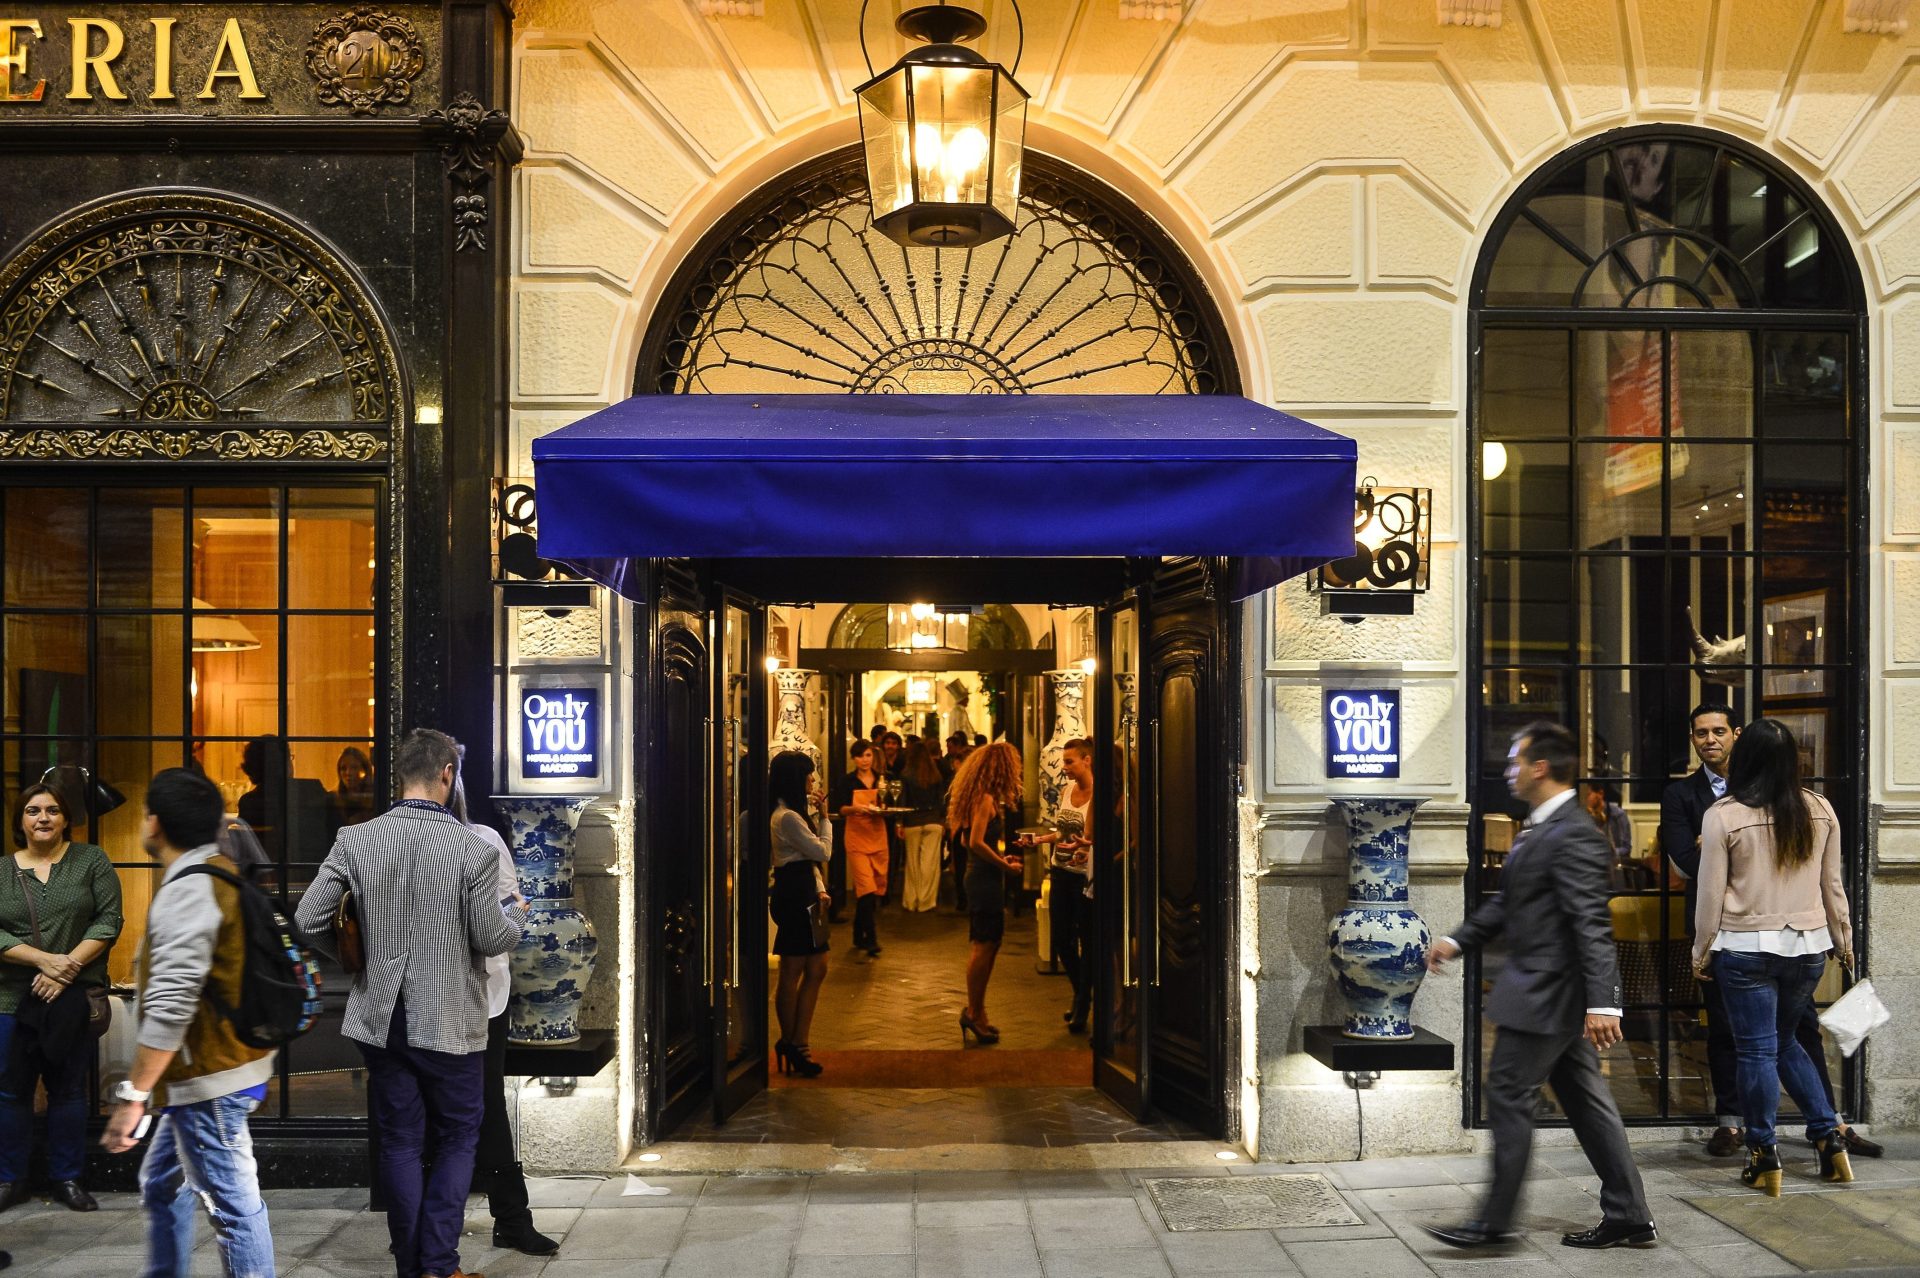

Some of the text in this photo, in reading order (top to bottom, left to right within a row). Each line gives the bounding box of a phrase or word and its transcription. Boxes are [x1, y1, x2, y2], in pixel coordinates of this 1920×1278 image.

[0, 17, 266, 101] ERIA
[342, 40, 382, 79] 21
[523, 693, 589, 725] Only
[1330, 694, 1394, 726] Only
[528, 719, 586, 752] YOU
[1334, 719, 1391, 752] YOU
